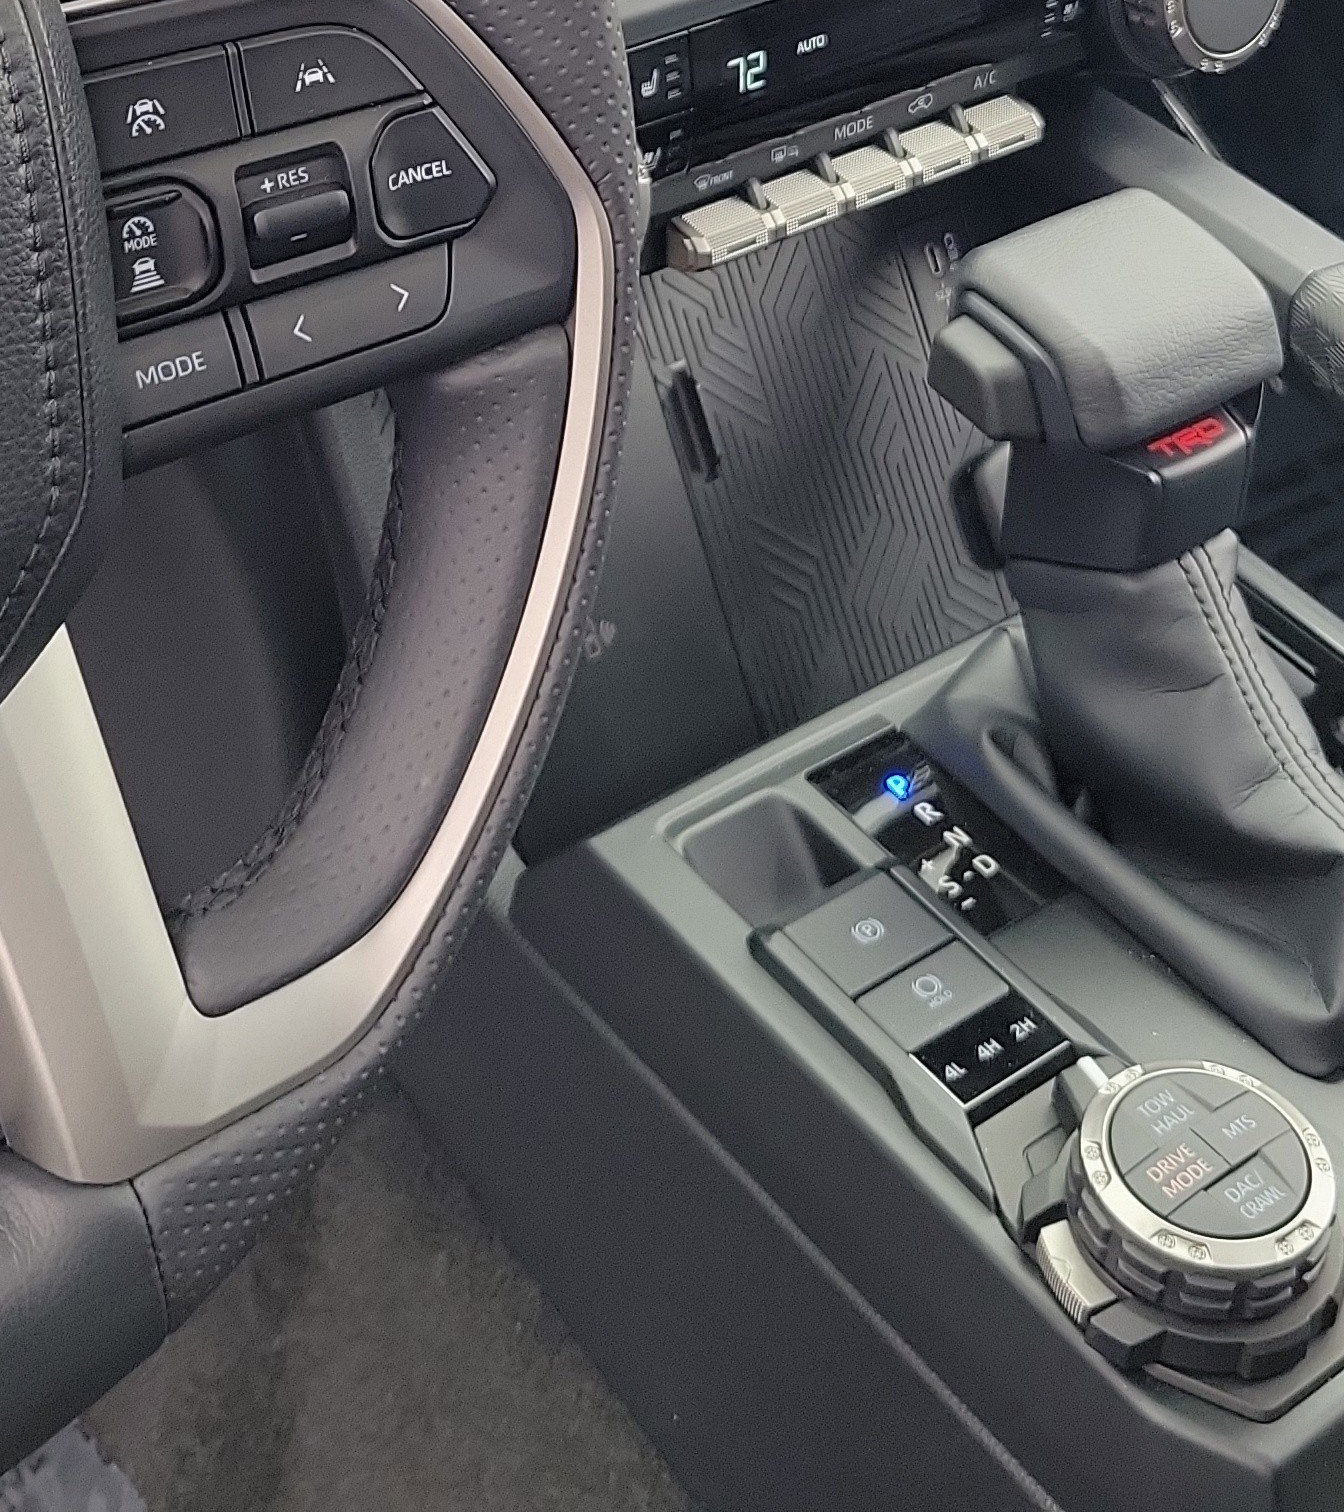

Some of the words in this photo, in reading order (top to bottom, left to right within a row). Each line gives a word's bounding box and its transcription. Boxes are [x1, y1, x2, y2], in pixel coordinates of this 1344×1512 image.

[796, 34, 828, 55] AUTO
[726, 50, 768, 94] 72
[973, 70, 997, 91] A/C
[834, 115, 874, 141] MODE
[388, 159, 452, 192] CANCEL
[123, 232, 158, 254] MODE
[135, 350, 208, 390] MODE
[885, 774, 910, 801] P
[914, 802, 945, 826] R
[942, 825, 973, 848] N
[971, 854, 1001, 879] D
[937, 875, 963, 898] S
[945, 1061, 968, 1082] 4L
[977, 1037, 1005, 1061] 4H
[1009, 1016, 1038, 1042] 2H
[1136, 1089, 1175, 1118] TOW
[1150, 1103, 1195, 1136] HAUL
[1221, 1114, 1257, 1140] MTS
[1146, 1142, 1196, 1183] DRIVE
[1161, 1157, 1214, 1199] MODE
[1224, 1169, 1265, 1203] DAC/
[1240, 1185, 1288, 1219] CRAWL
